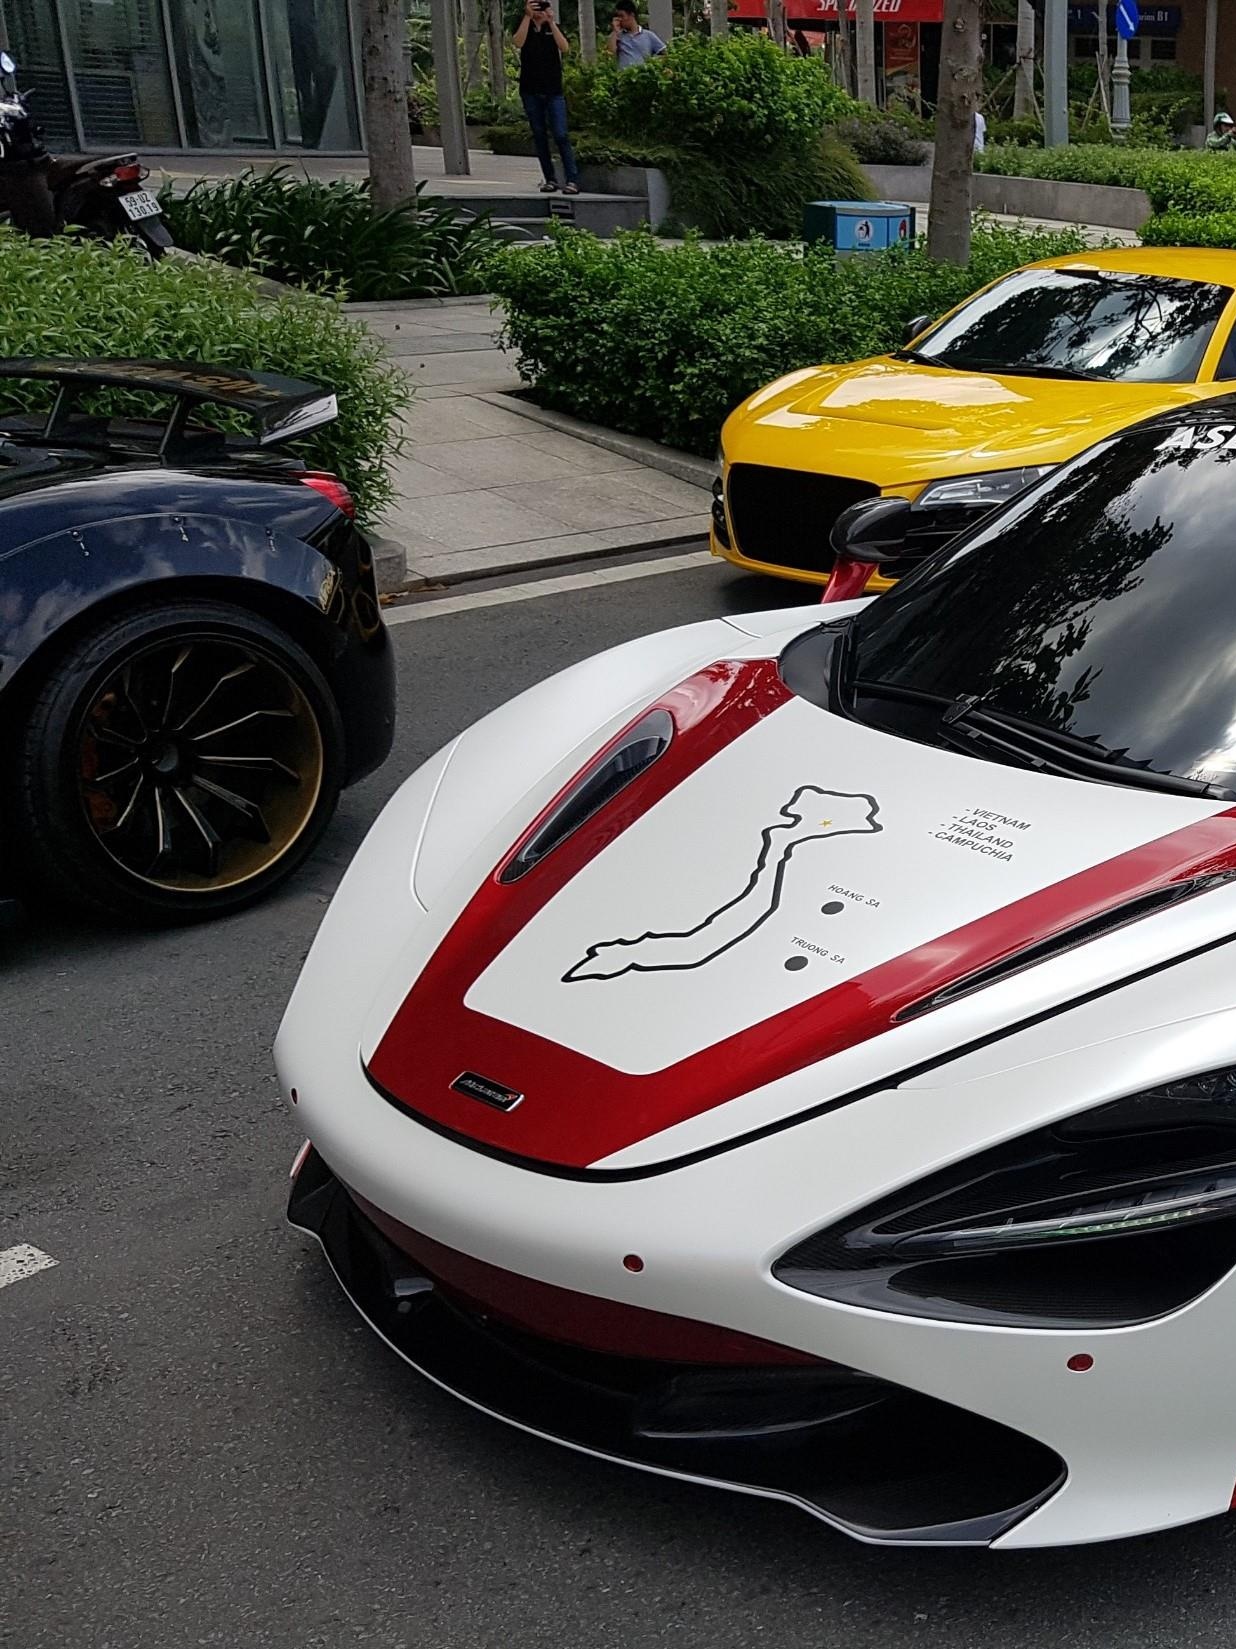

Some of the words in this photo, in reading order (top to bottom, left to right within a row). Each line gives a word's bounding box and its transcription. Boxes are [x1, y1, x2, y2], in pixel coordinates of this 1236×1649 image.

[959, 816, 997, 831] LAOS
[973, 808, 1031, 830] VIETNAM
[934, 831, 1013, 862] CAMPUCHIA
[948, 823, 1014, 849] THAILAND
[828, 884, 865, 902] HOANG
[865, 898, 881, 908] SA
[790, 936, 829, 957] TRUONG
[830, 954, 846, 964] SA
